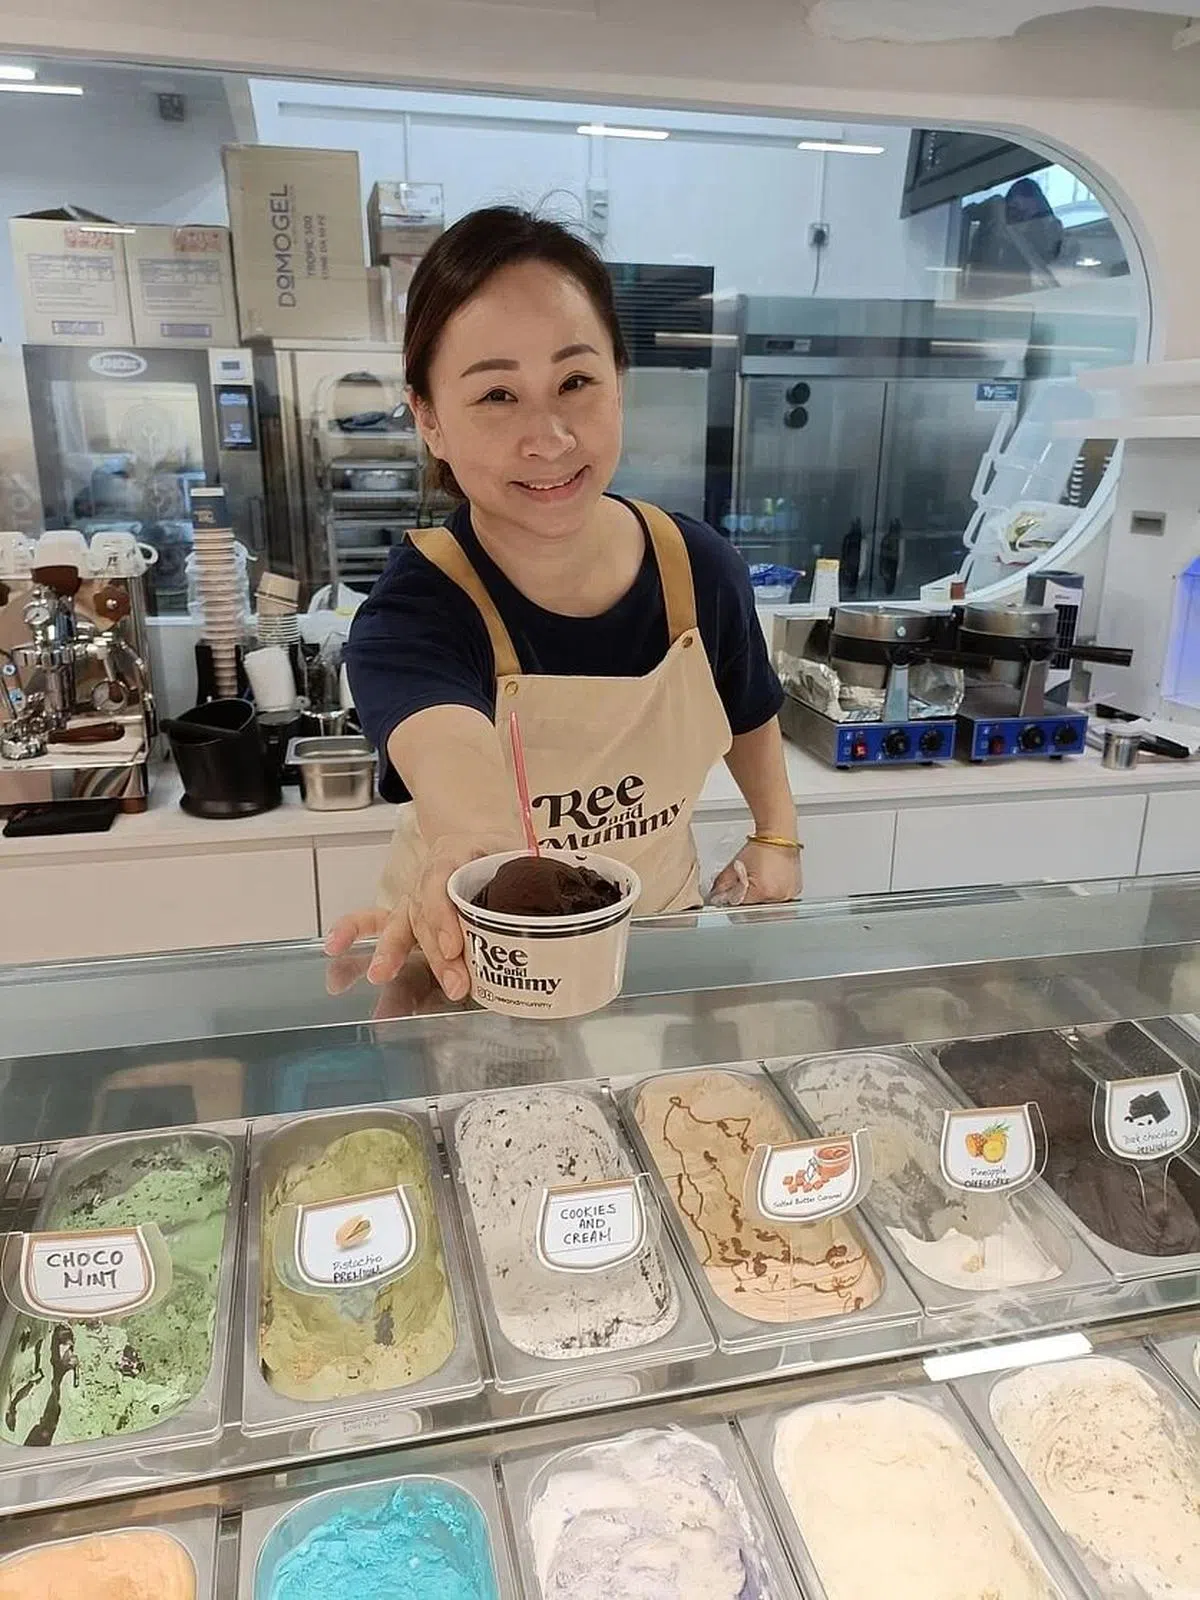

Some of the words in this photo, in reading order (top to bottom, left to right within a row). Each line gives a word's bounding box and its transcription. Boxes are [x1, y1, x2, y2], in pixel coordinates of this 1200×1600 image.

[270, 184, 297, 308] DOMOGEL
[531, 775, 645, 830] Ree
[538, 798, 687, 851] Mummy
[608, 803, 643, 826] and
[466, 930, 529, 971] Ree
[504, 967, 527, 977] and
[560, 1203, 617, 1220] COOKIES
[578, 1218, 606, 1229] AND
[563, 1227, 612, 1245] CREAM
[46, 1250, 124, 1268] CHOCO
[63, 1269, 118, 1289] MINT
